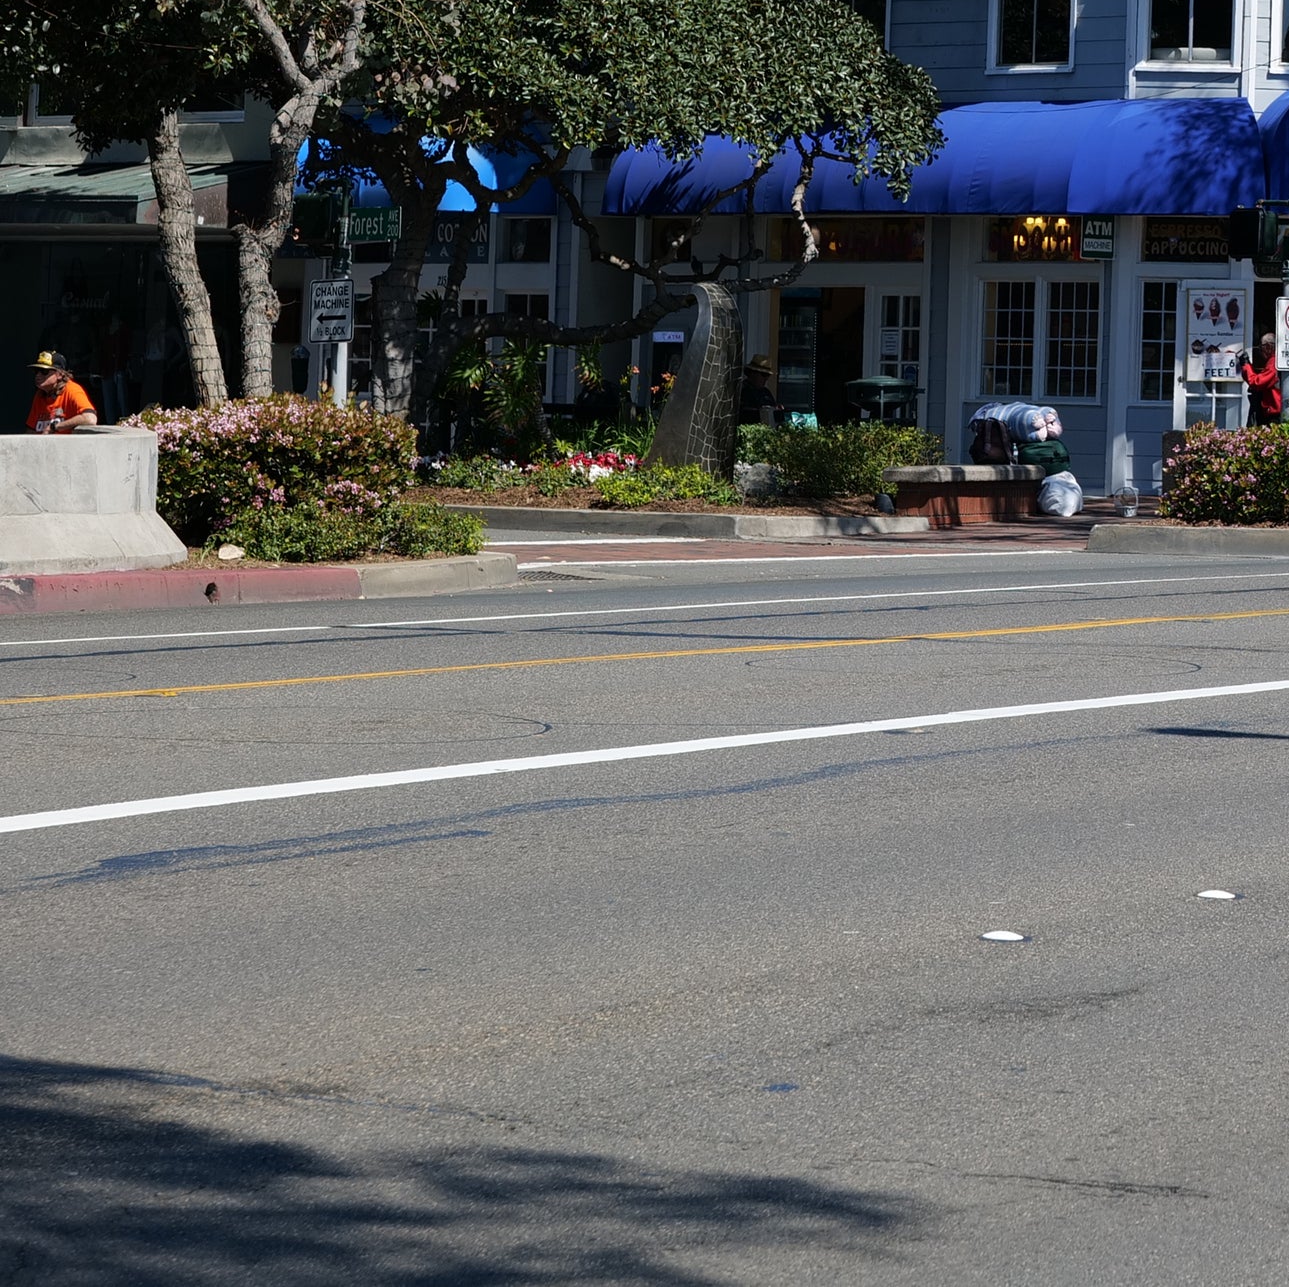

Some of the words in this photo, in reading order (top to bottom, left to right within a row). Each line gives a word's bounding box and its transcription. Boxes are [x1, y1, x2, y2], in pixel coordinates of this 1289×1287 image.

[350, 213, 384, 236] Forest
[388, 210, 398, 222] AVE
[1085, 220, 1112, 236] ATM
[386, 224, 399, 237] 200
[1151, 223, 1222, 238] ESPRESSO
[1084, 239, 1111, 250] MACHINE
[1143, 240, 1229, 256] CAPPUCCINO
[315, 285, 350, 298] CHANGE
[313, 298, 350, 310] MACHINE
[325, 326, 346, 336] BLOCK
[1204, 368, 1230, 377] FEET
